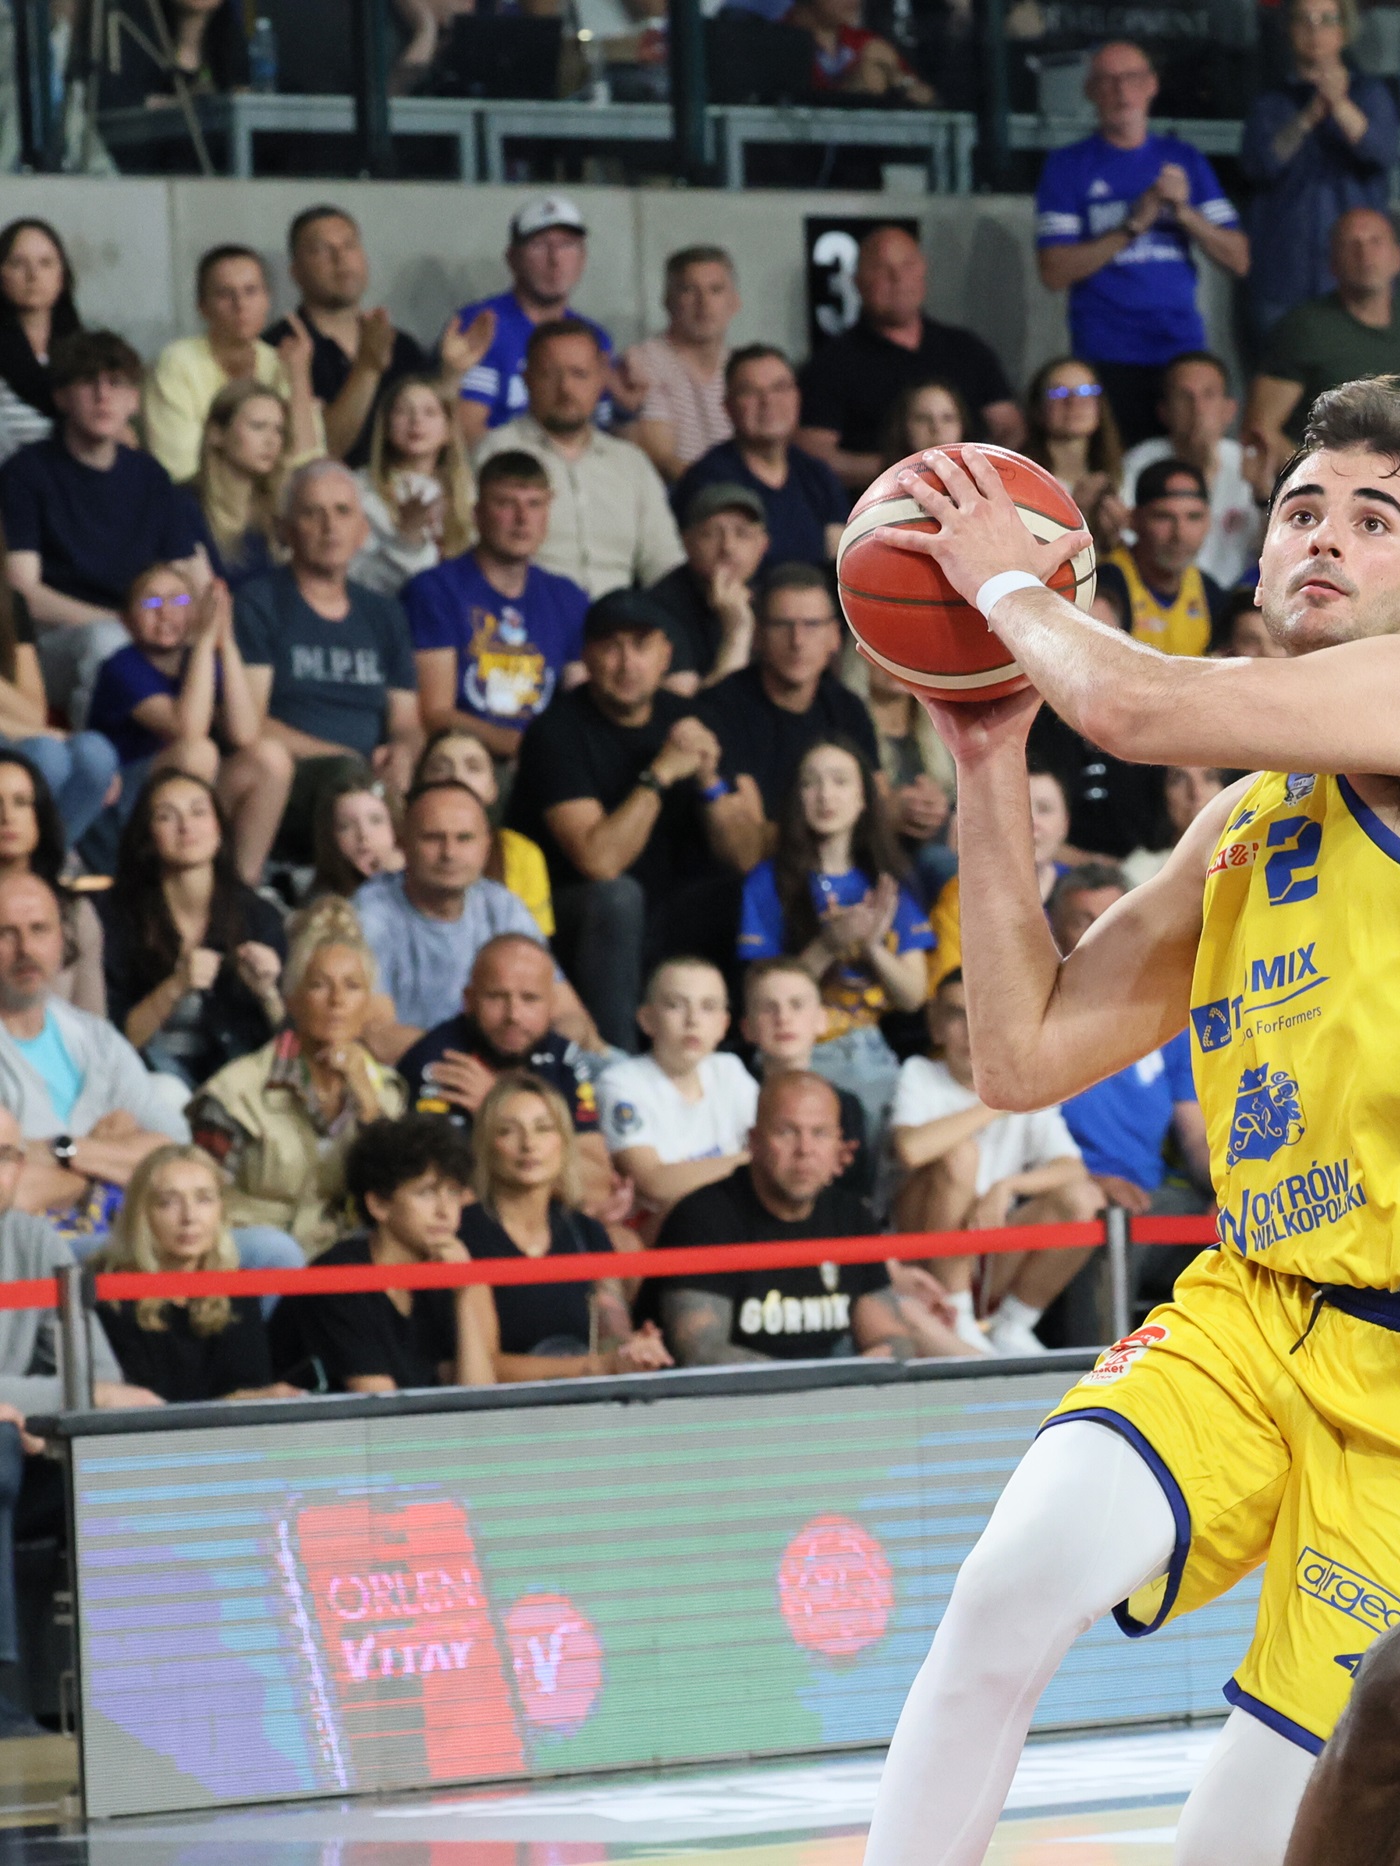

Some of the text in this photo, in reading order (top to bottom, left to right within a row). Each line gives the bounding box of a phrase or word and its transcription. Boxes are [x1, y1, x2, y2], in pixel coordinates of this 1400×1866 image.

[813, 230, 862, 336] 3
[1265, 815, 1323, 907] 2
[1256, 1006, 1322, 1035] ForFarmers
[740, 1289, 851, 1335] GÓRNIK
[328, 1568, 478, 1620] ORLEN
